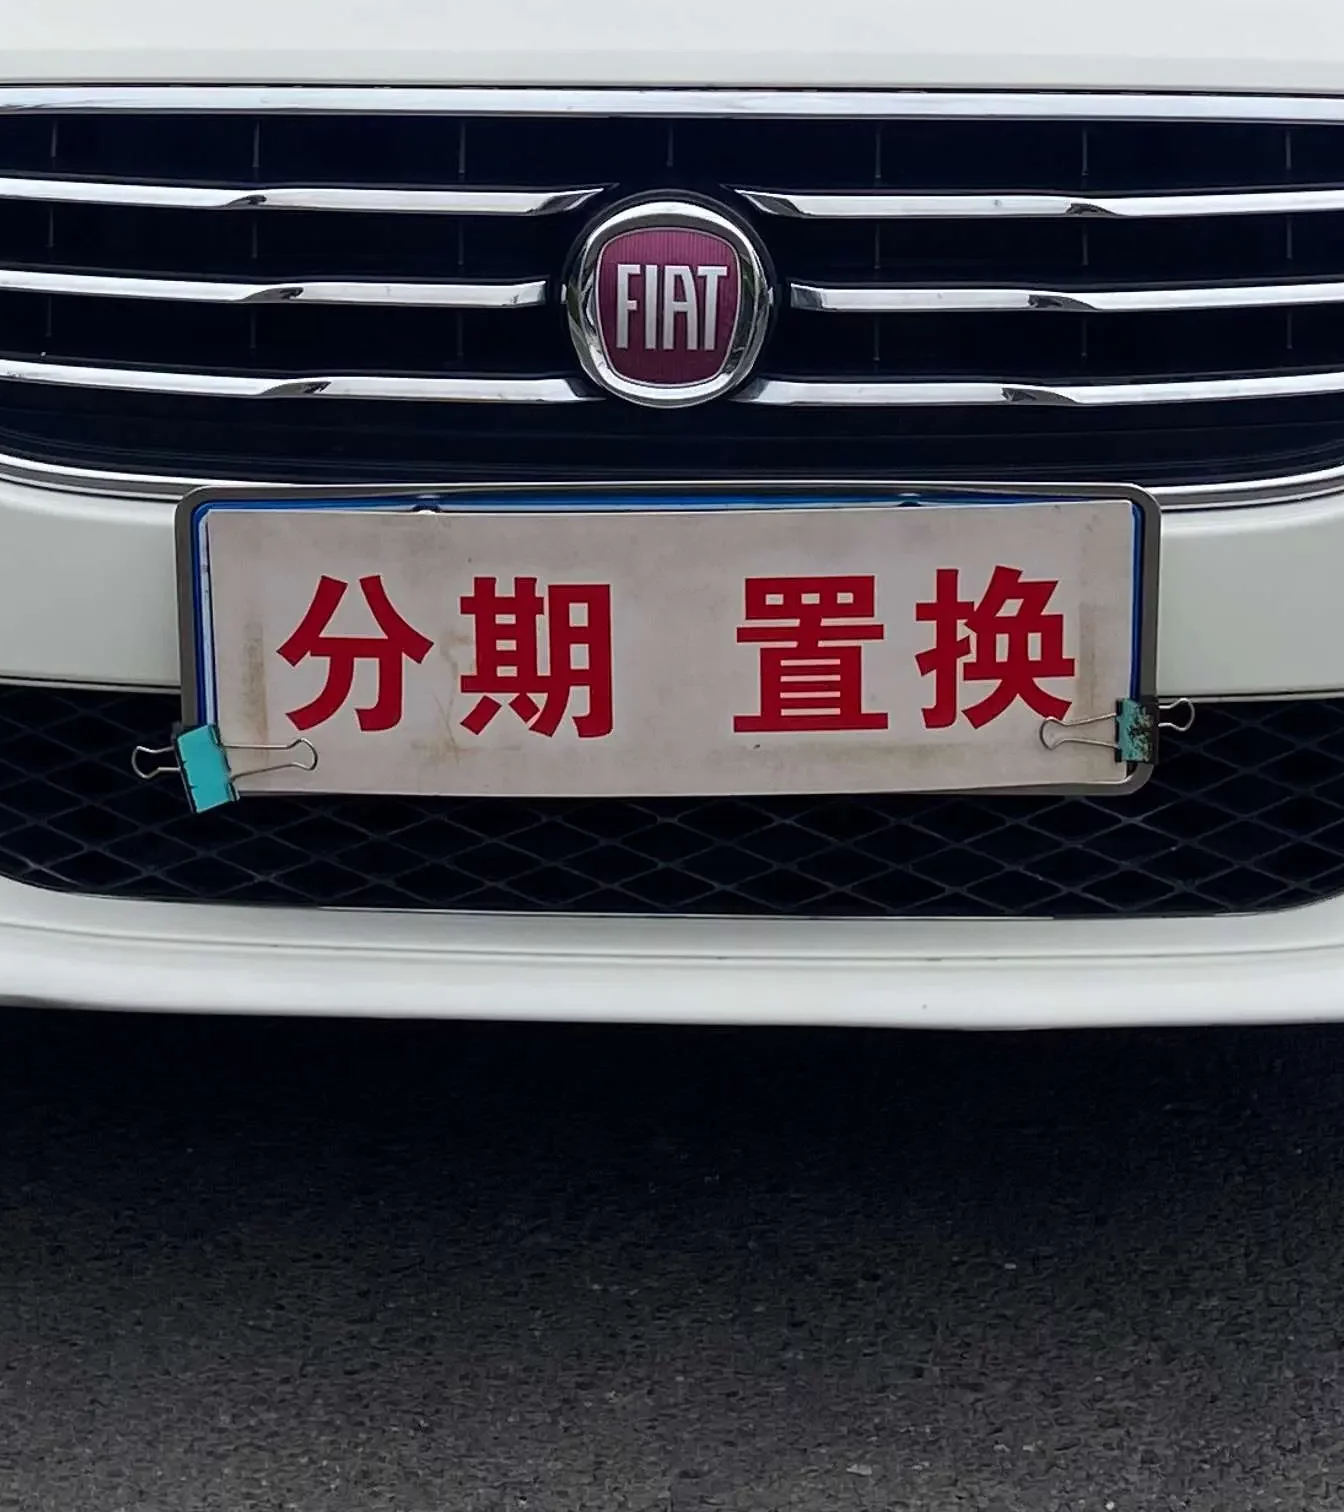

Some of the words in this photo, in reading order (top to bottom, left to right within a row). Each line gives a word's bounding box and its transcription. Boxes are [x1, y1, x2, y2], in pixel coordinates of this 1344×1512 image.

[616, 263, 728, 351] FIAT
[276, 574, 614, 738] 分期
[733, 565, 1077, 733] 置换
